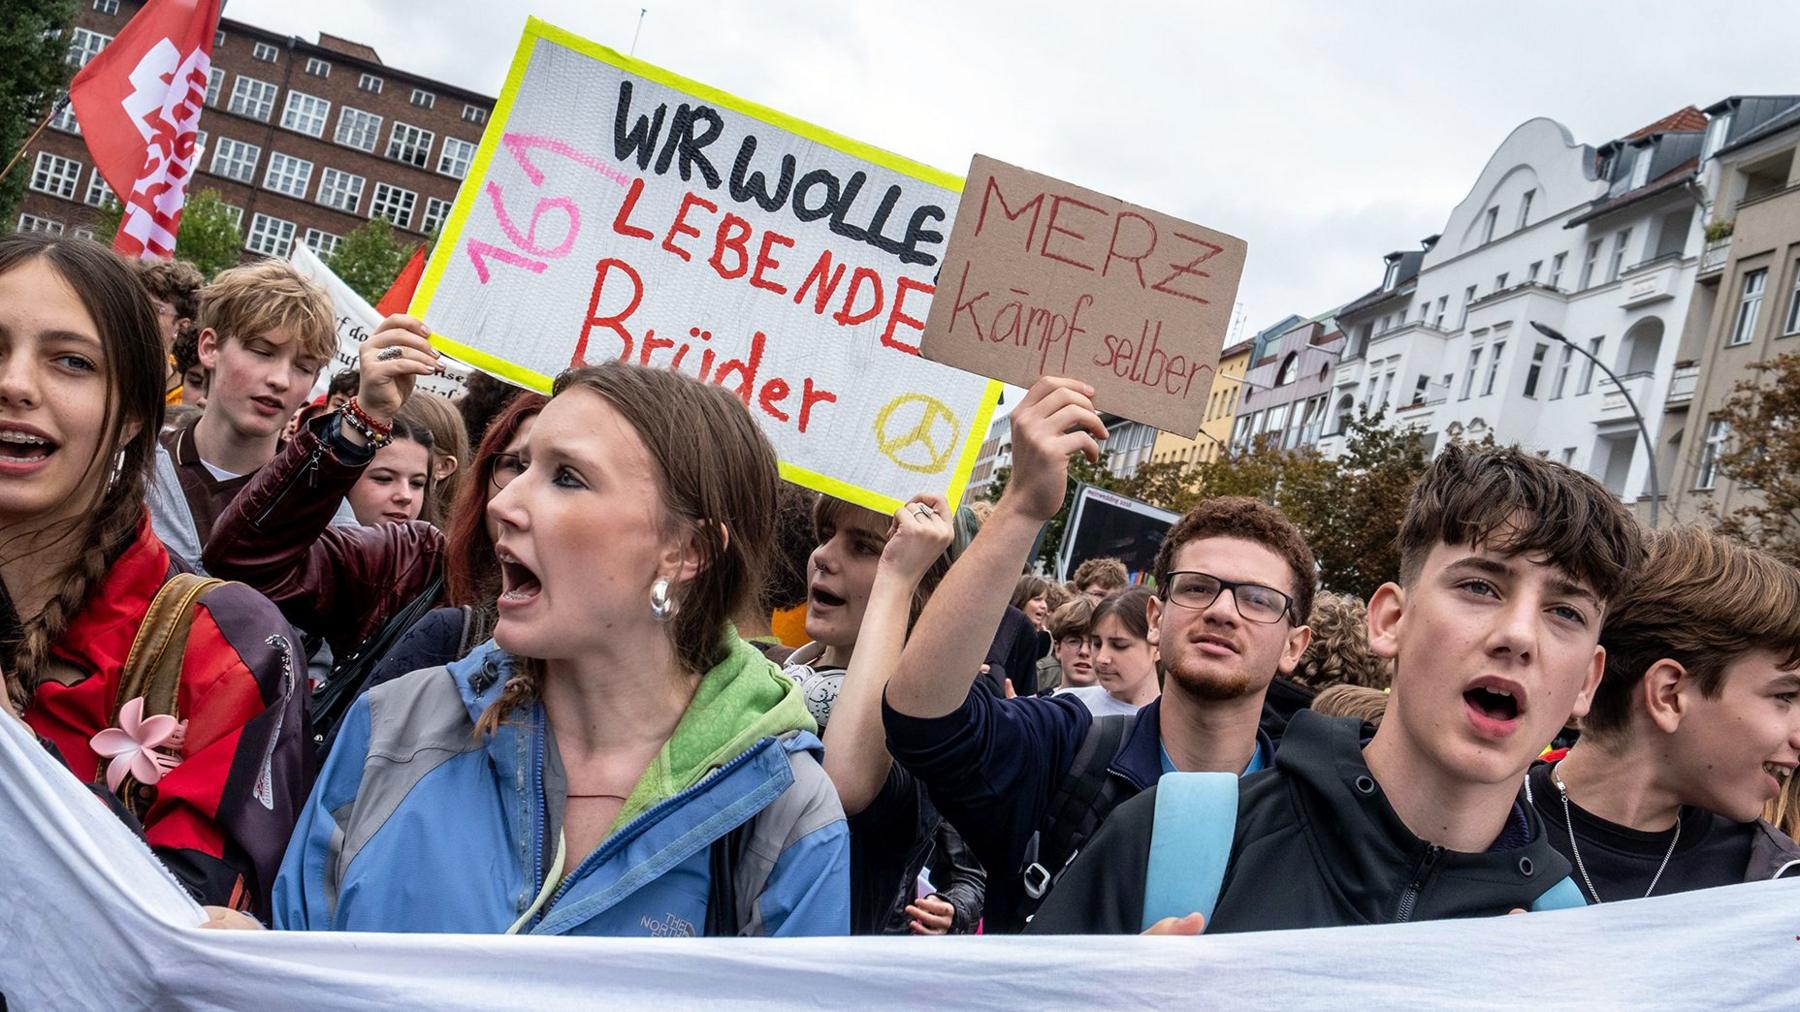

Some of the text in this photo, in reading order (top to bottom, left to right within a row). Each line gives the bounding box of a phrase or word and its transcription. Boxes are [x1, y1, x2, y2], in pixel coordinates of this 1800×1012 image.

[465, 132, 630, 285] 161
[613, 80, 946, 285] WIR WOLLE
[973, 174, 1225, 305] MERZ
[612, 177, 937, 356] LEBENDE
[570, 257, 838, 434] Brüder
[1093, 319, 1215, 400] selber
[666, 912, 687, 931] THE
